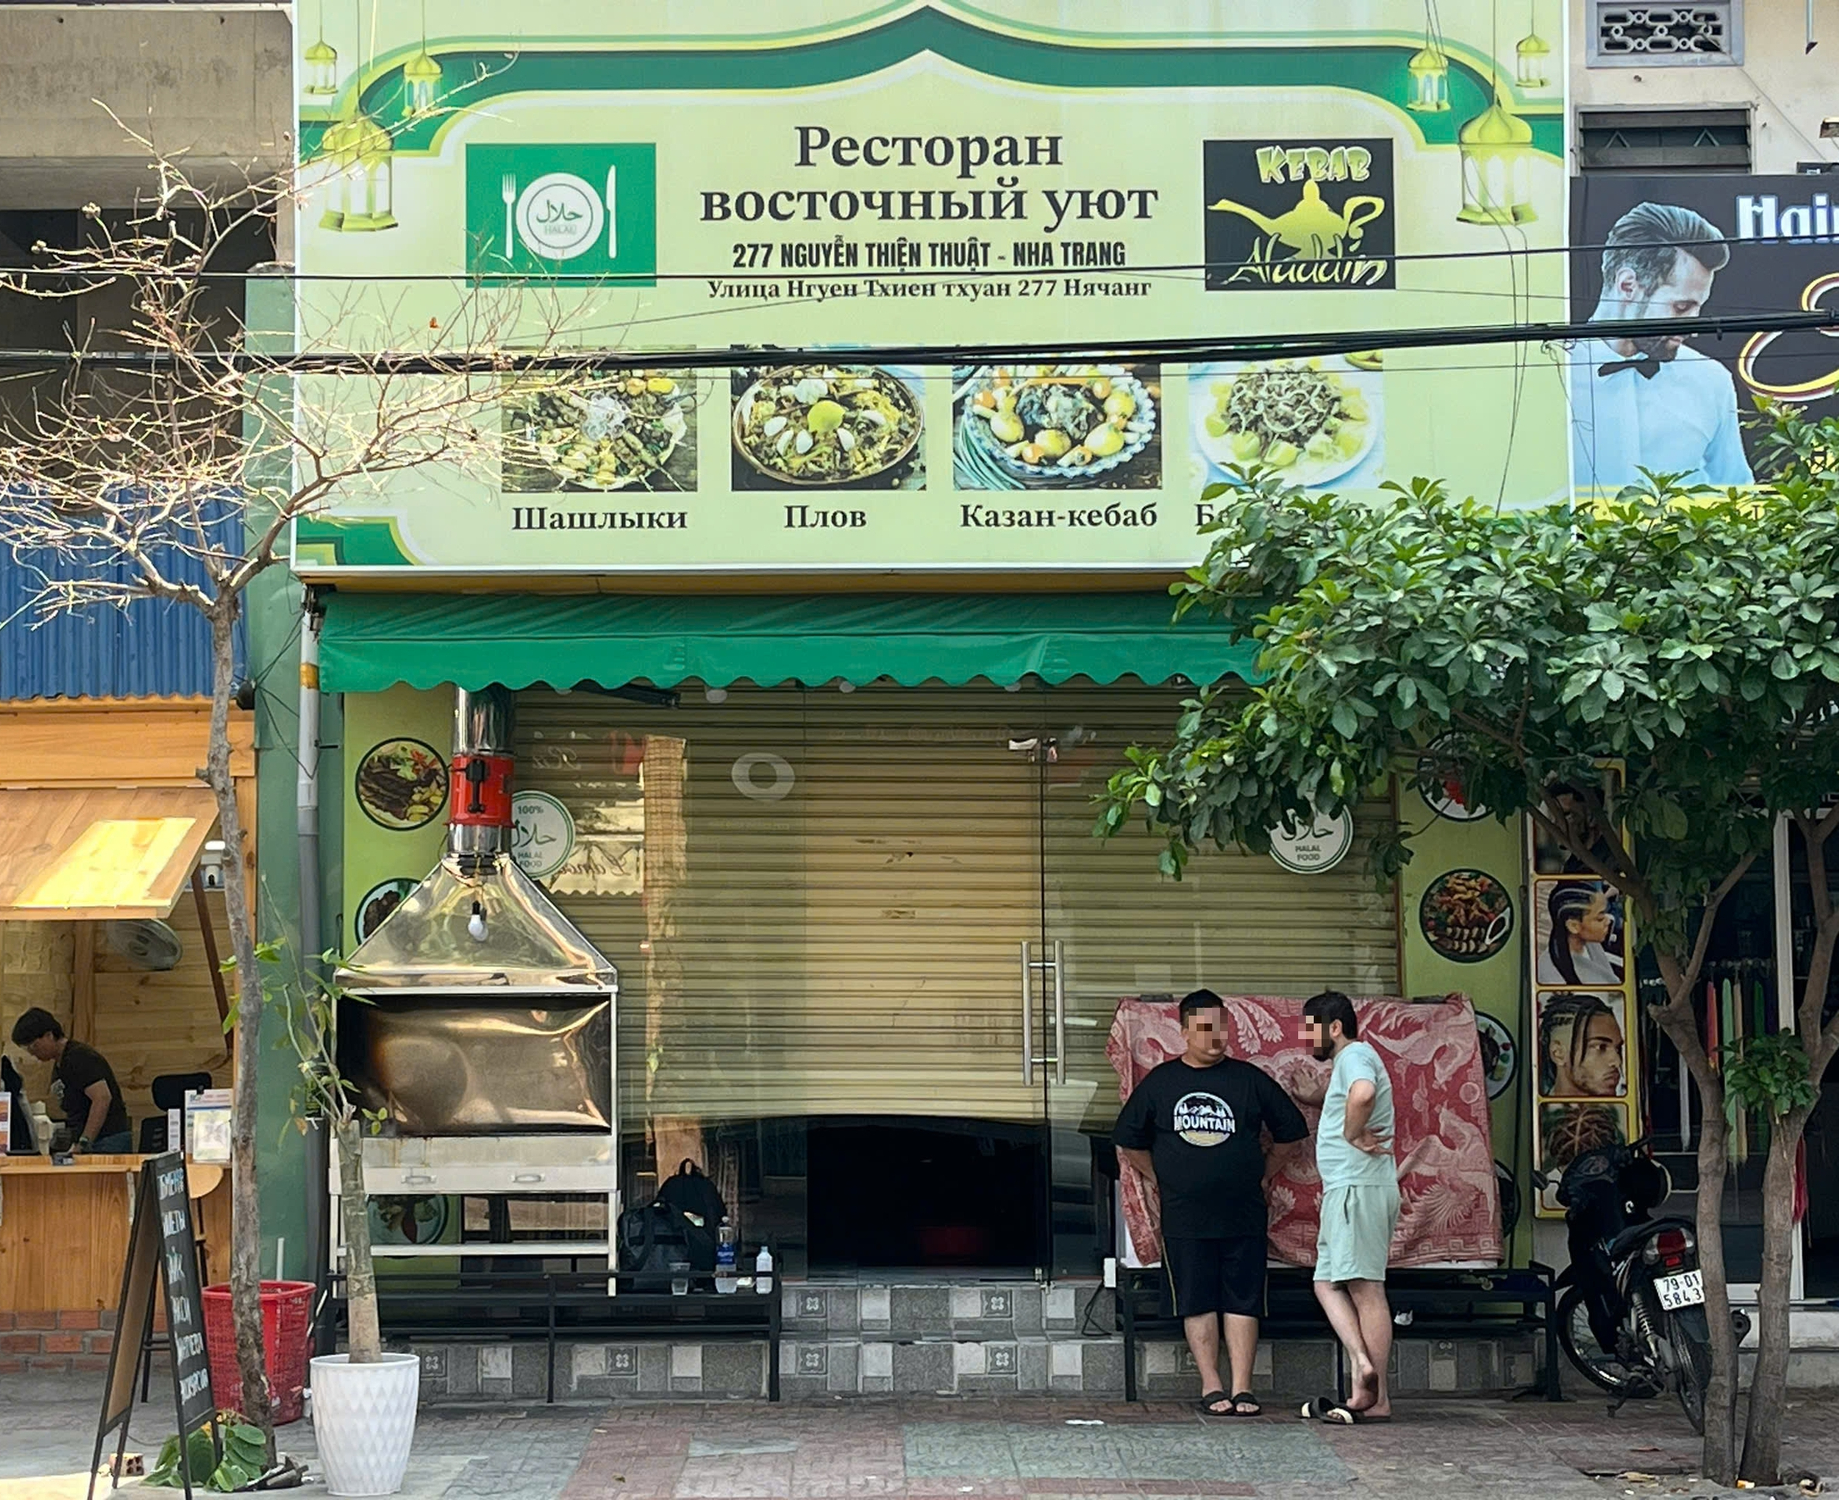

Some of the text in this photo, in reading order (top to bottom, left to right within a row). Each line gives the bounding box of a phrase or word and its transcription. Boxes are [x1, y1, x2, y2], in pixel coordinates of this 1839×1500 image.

[795, 126, 1063, 179] Ресторан
[1256, 146, 1372, 184] KEBAB
[536, 199, 583, 224] حلال
[701, 176, 1159, 234] восточный уют
[733, 243, 773, 268] 277
[781, 235, 858, 268] NGUYỄN
[865, 237, 921, 272] THIỆN
[929, 237, 991, 271] THUẬT
[1014, 242, 1054, 266] NHA
[1061, 242, 1126, 266] TRANG
[708, 279, 1152, 302] Улица Нгуен Тхиен тхуан 277 Нячанг
[513, 507, 688, 530] Шашлыки
[785, 505, 867, 528] Плов
[961, 503, 1157, 529] Казан-кебаб
[518, 805, 544, 815] 100%
[1174, 1115, 1236, 1134] MOUNTAIN
[1663, 1288, 1702, 1308] 5843
